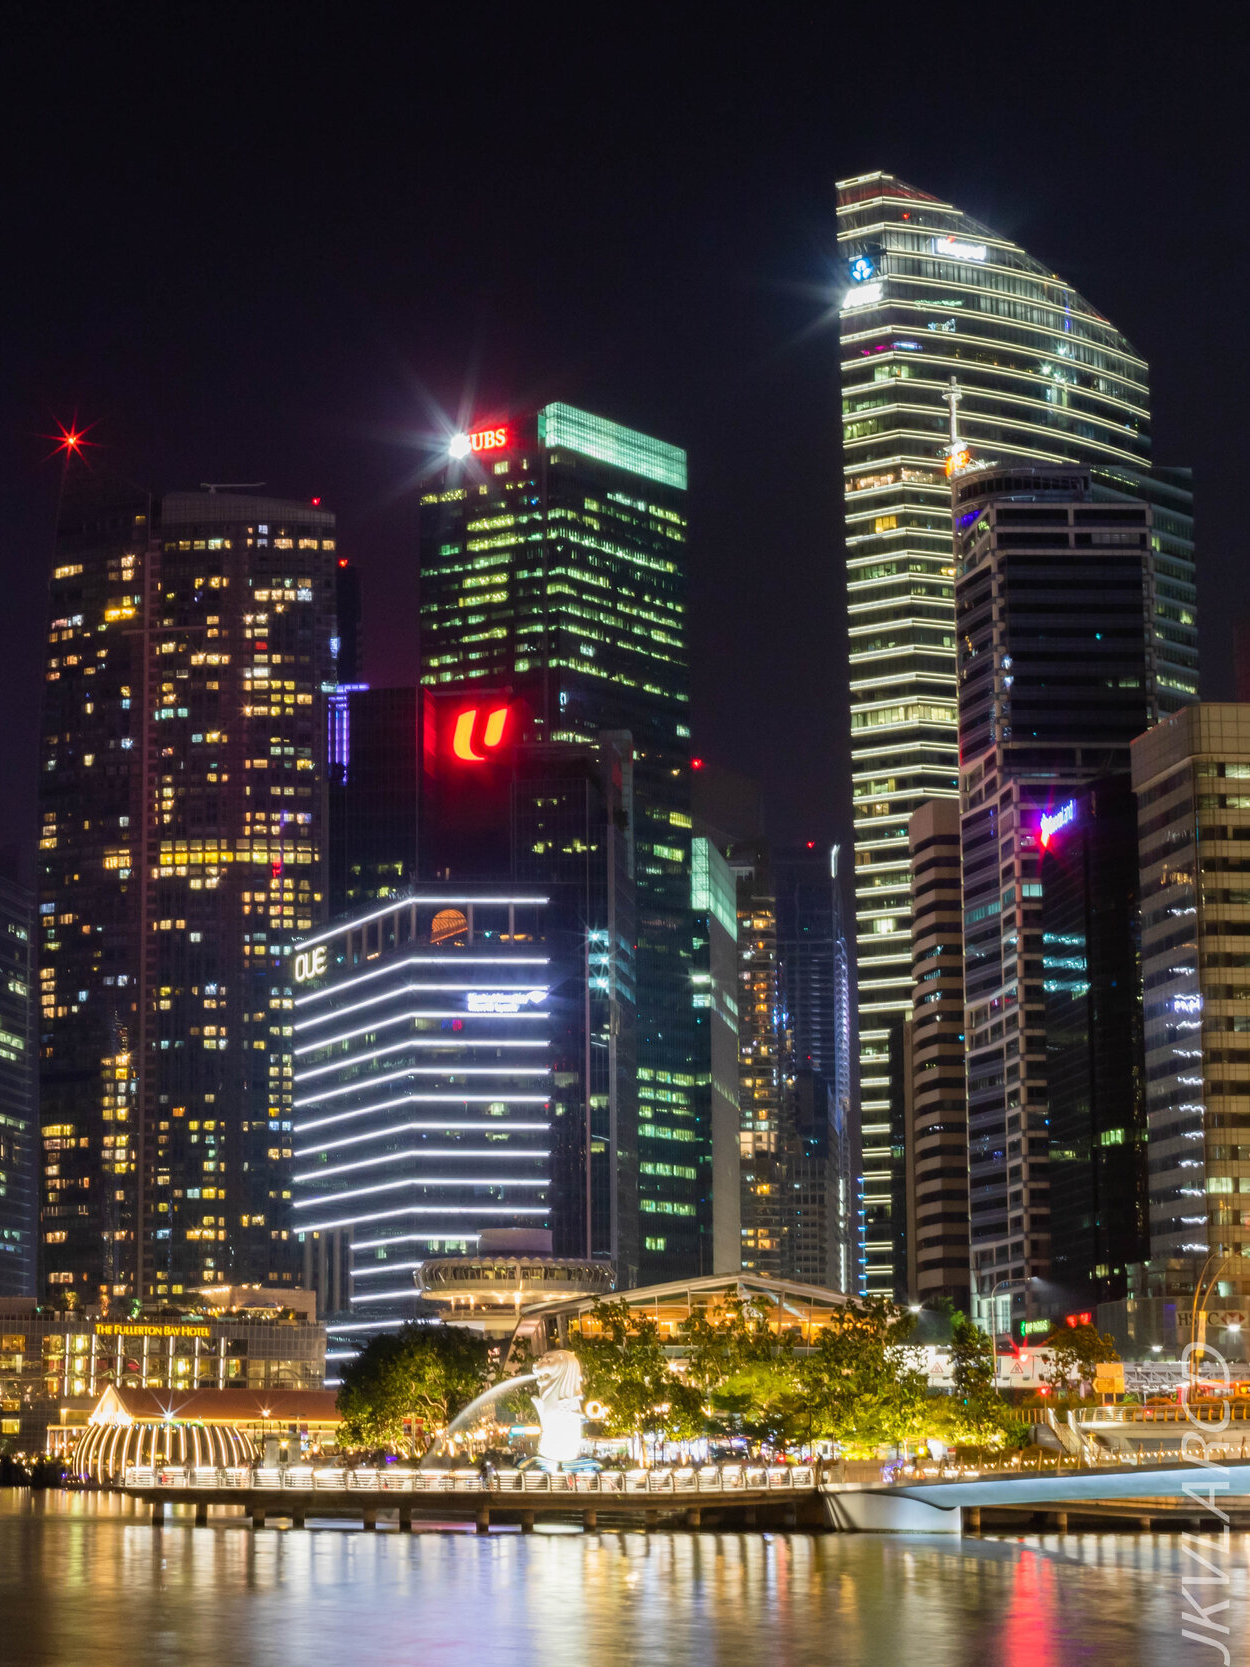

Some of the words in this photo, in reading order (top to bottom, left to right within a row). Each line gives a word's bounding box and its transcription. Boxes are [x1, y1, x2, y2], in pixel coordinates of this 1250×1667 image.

[470, 428, 508, 451] UBS
[295, 946, 328, 983] OUE
[1177, 1312, 1219, 1326] HSC
[95, 1324, 113, 1335] THE
[114, 1324, 162, 1336] FULLERTON
[163, 1325, 180, 1336] BAY
[181, 1326, 210, 1337] HOTEL
